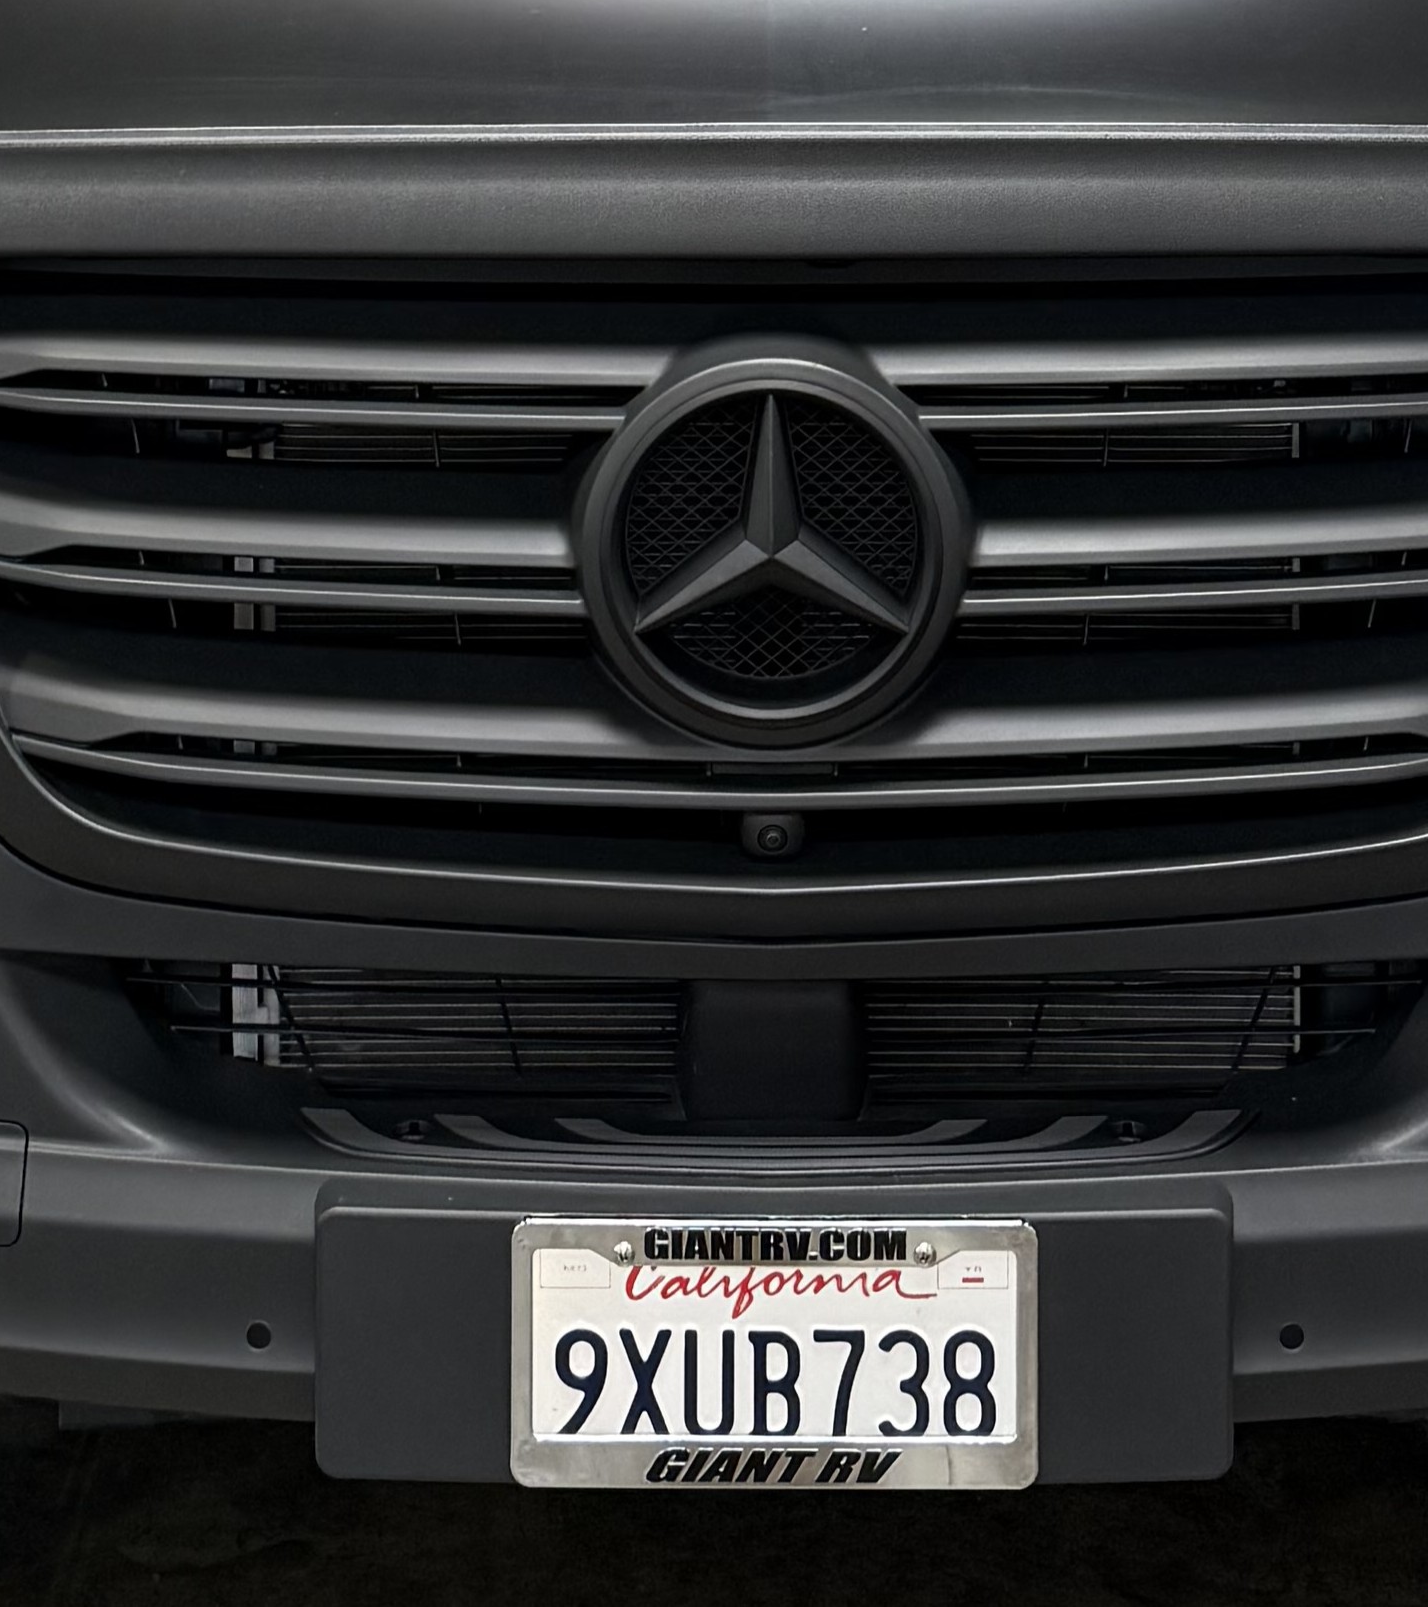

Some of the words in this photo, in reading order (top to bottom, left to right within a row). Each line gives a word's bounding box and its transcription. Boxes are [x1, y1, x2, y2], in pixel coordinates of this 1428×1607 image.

[643, 1227, 908, 1262] GIANTRV.COM
[625, 1265, 938, 1320] California
[554, 1327, 996, 1437] 9XUB738
[644, 1447, 817, 1485] GIANT
[818, 1447, 904, 1485] RV
